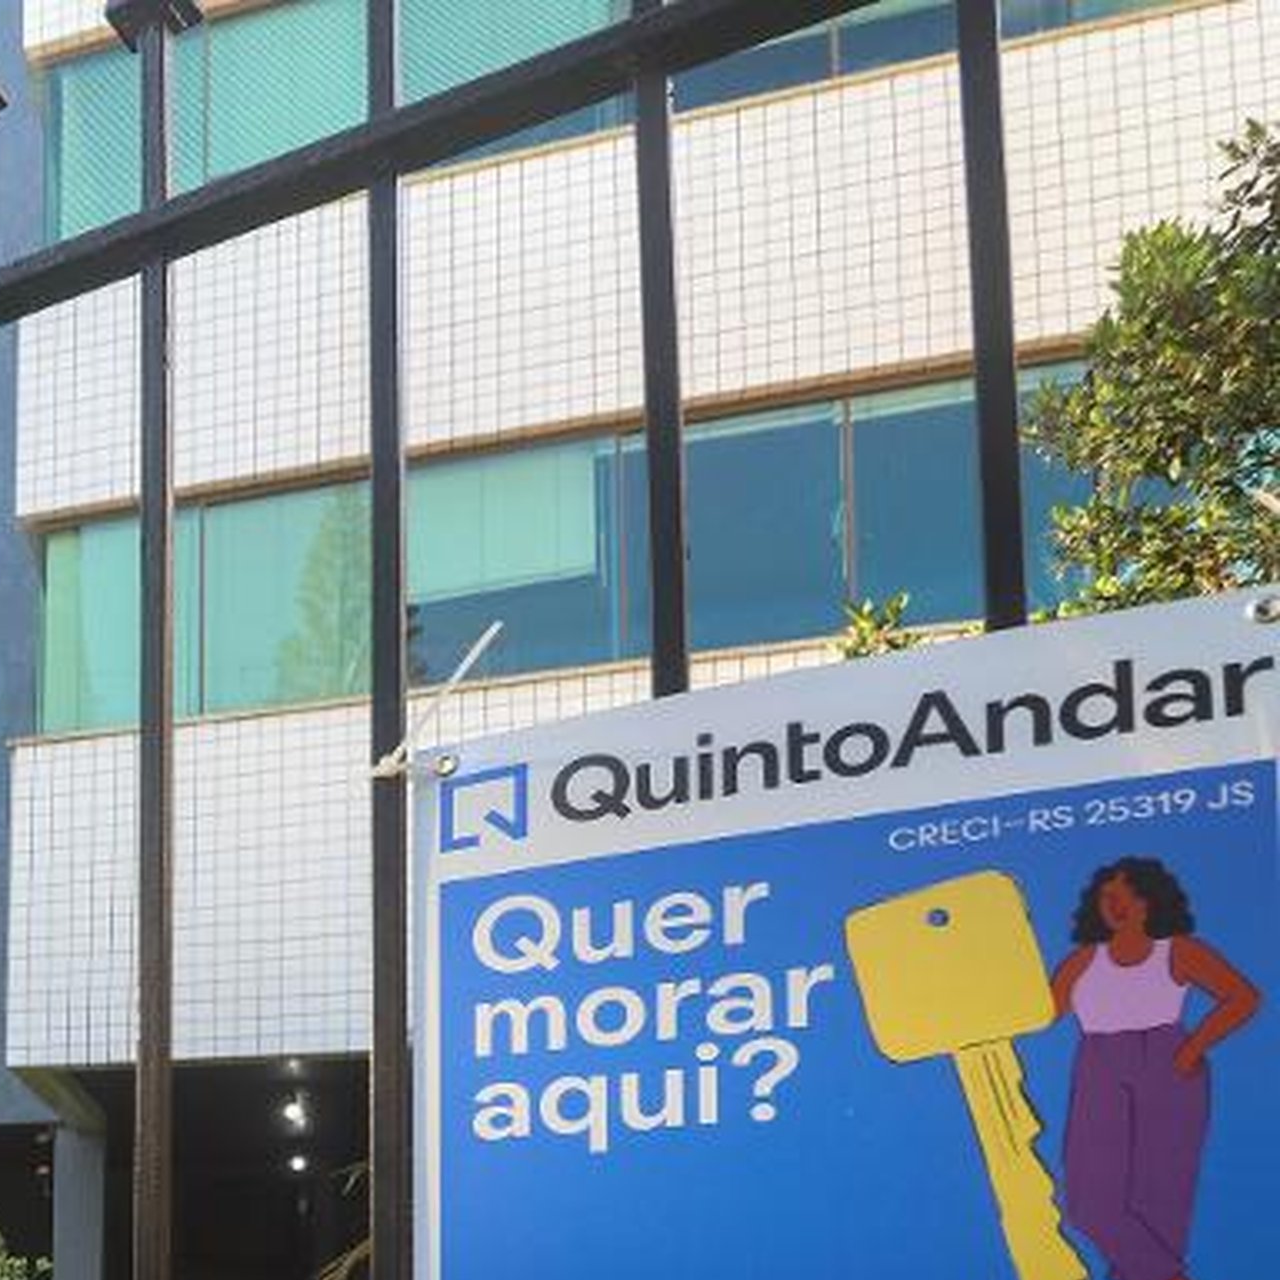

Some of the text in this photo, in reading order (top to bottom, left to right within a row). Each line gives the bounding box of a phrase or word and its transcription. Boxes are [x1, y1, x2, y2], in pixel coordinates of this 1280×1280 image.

[551, 656, 1274, 822] QuintoAndar
[889, 780, 1256, 852] CRECI-RS 25319 JS
[473, 880, 769, 974] Quer
[475, 963, 833, 1057] morar
[472, 1036, 800, 1153] aqui?
